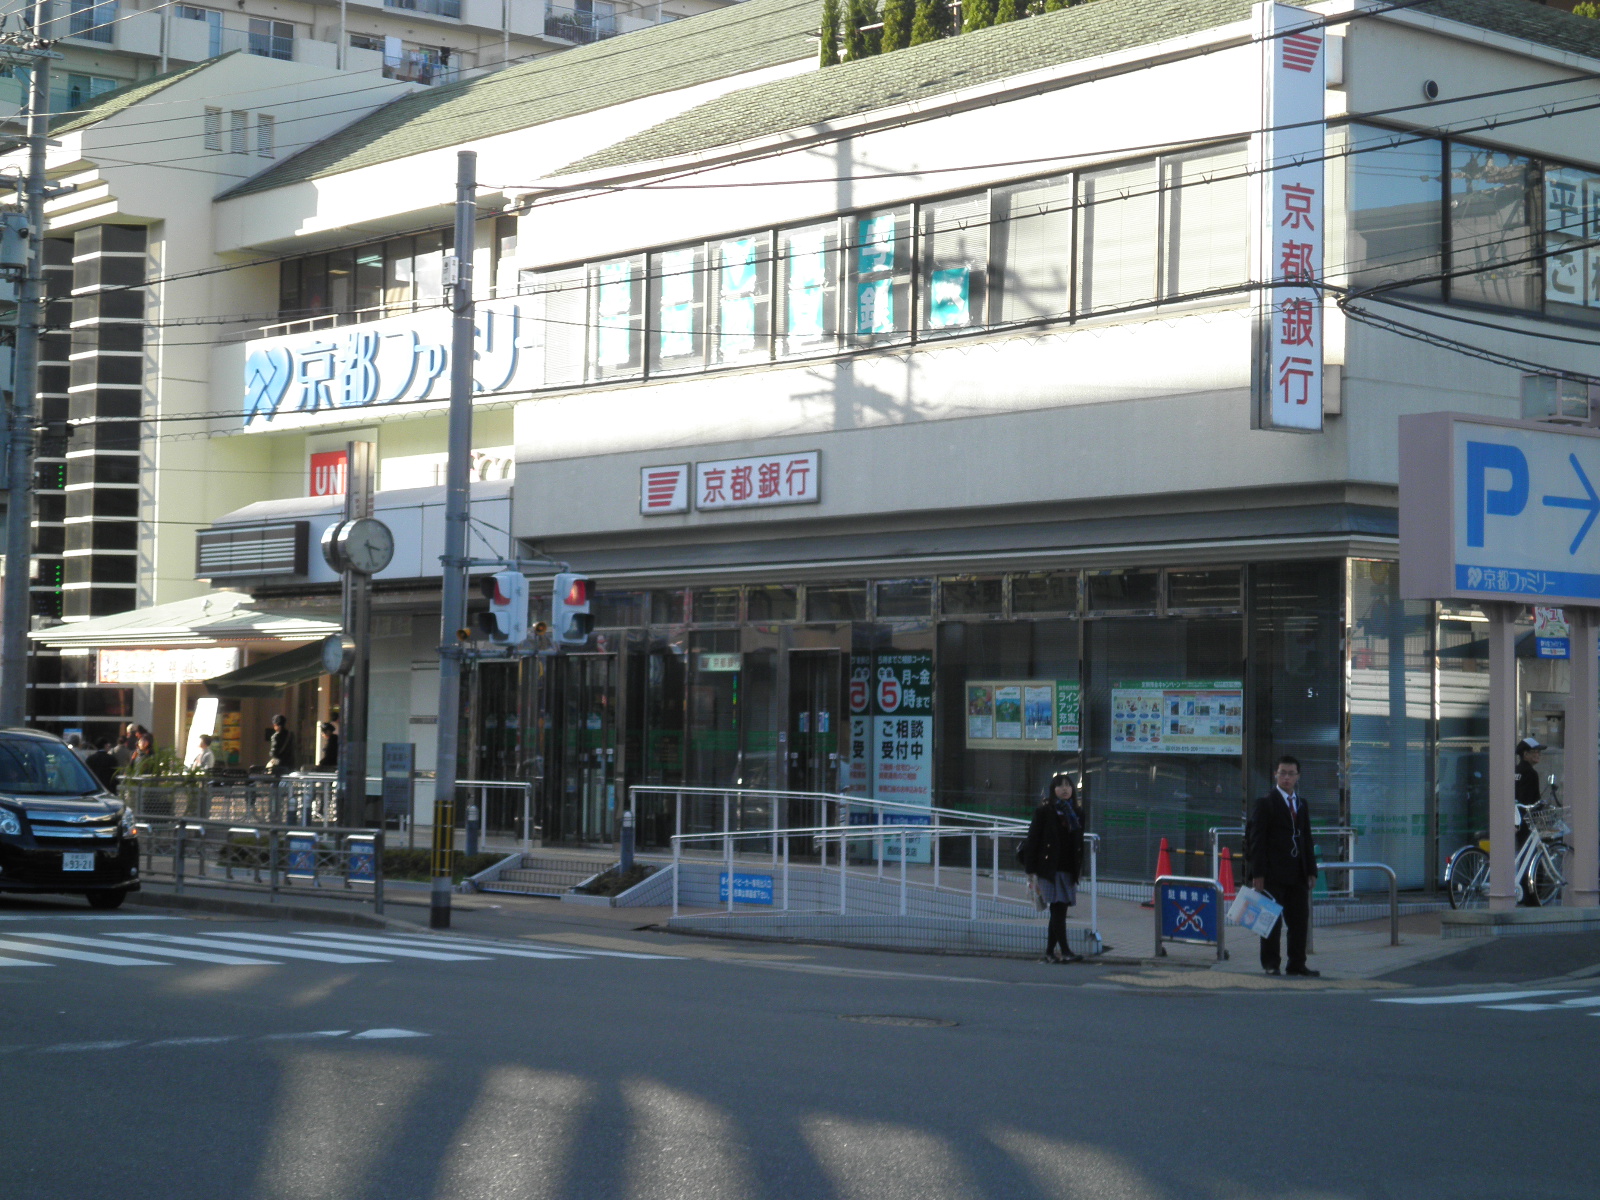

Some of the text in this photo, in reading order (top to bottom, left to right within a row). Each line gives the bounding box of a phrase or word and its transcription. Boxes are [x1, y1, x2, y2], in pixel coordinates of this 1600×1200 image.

[1280, 182, 1315, 405] 京都銀行
[703, 459, 810, 502] 京都銀行
[1466, 441, 1529, 548] P
[1484, 569, 1555, 593] 京都ファミリー
[902, 669, 930, 685] 月～金
[882, 682, 930, 708] 5 時まで
[1059, 692, 1079, 702] ライン
[883, 720, 923, 738] ご相談
[882, 741, 923, 760] 受付中
